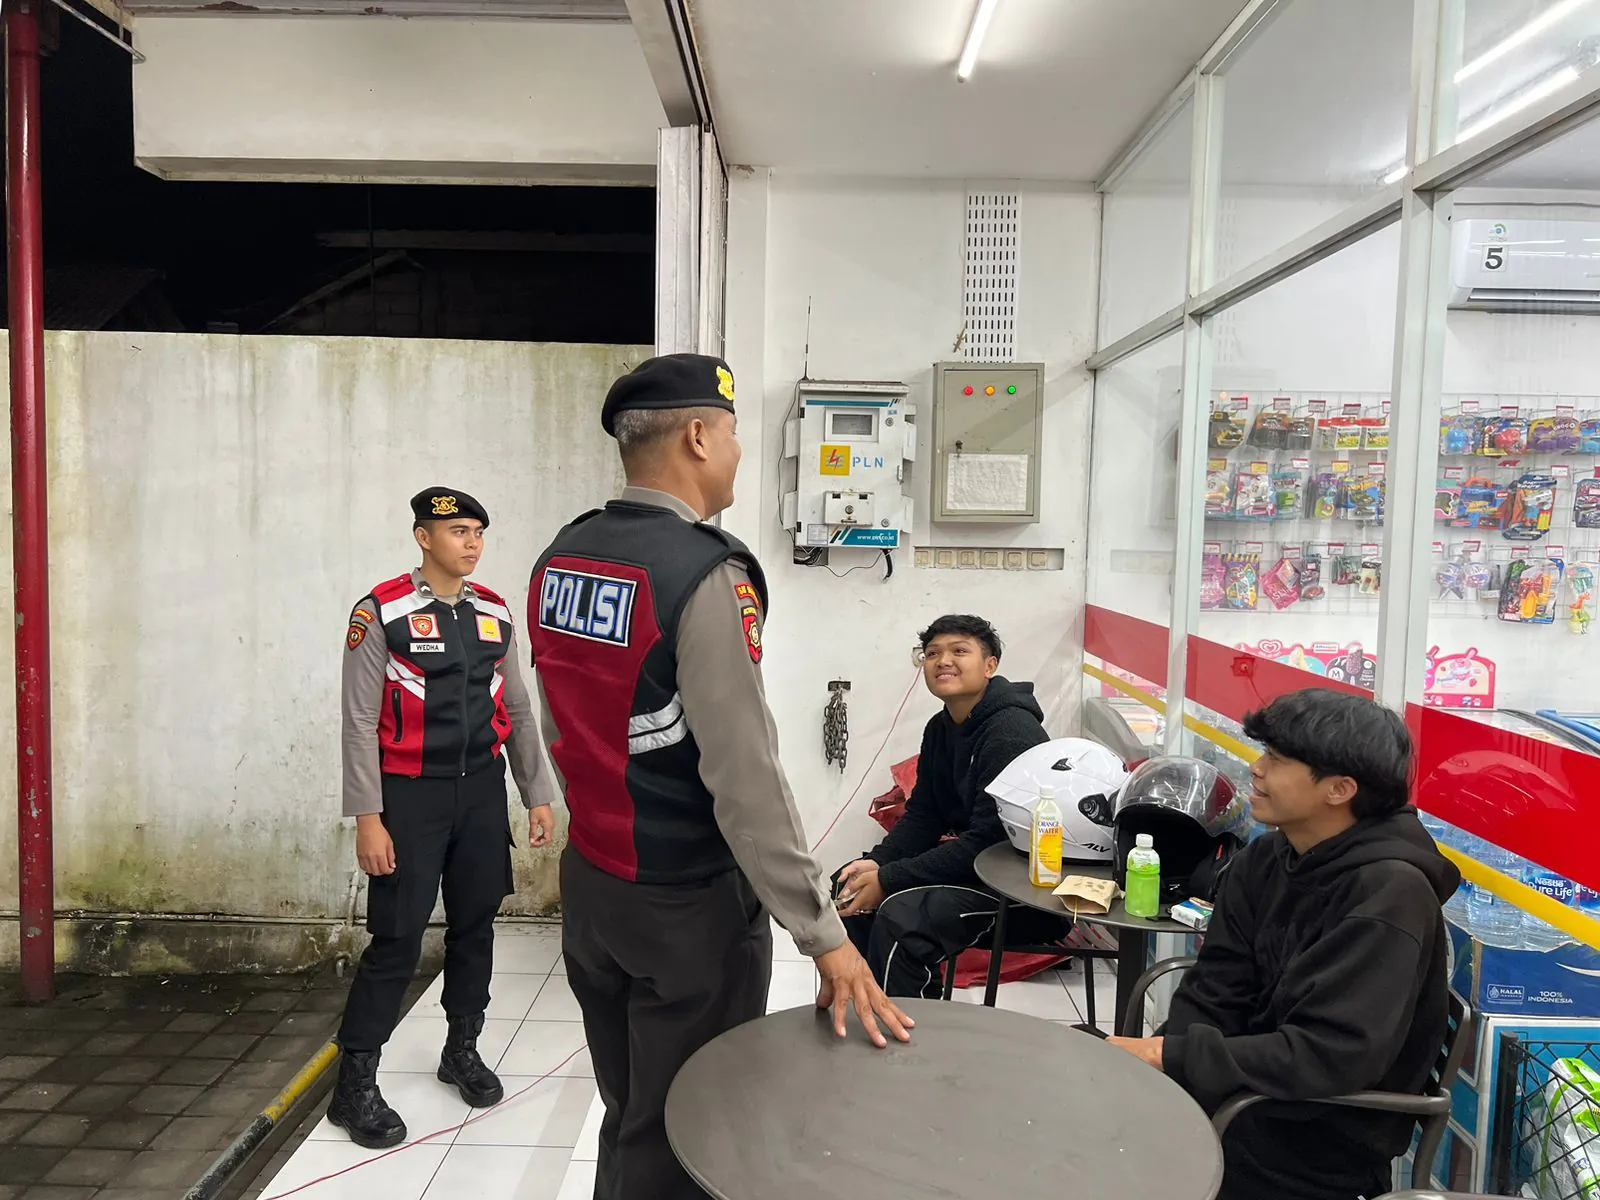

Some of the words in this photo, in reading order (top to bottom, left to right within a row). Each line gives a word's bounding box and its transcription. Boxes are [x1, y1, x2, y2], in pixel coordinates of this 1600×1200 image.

[1484, 247, 1503, 270] 5
[852, 456, 883, 468] PLN
[541, 572, 631, 640] POLISI
[1554, 887, 1573, 900] Life
[1528, 996, 1573, 1004] INDONESIA
[1540, 990, 1563, 998] 100%
